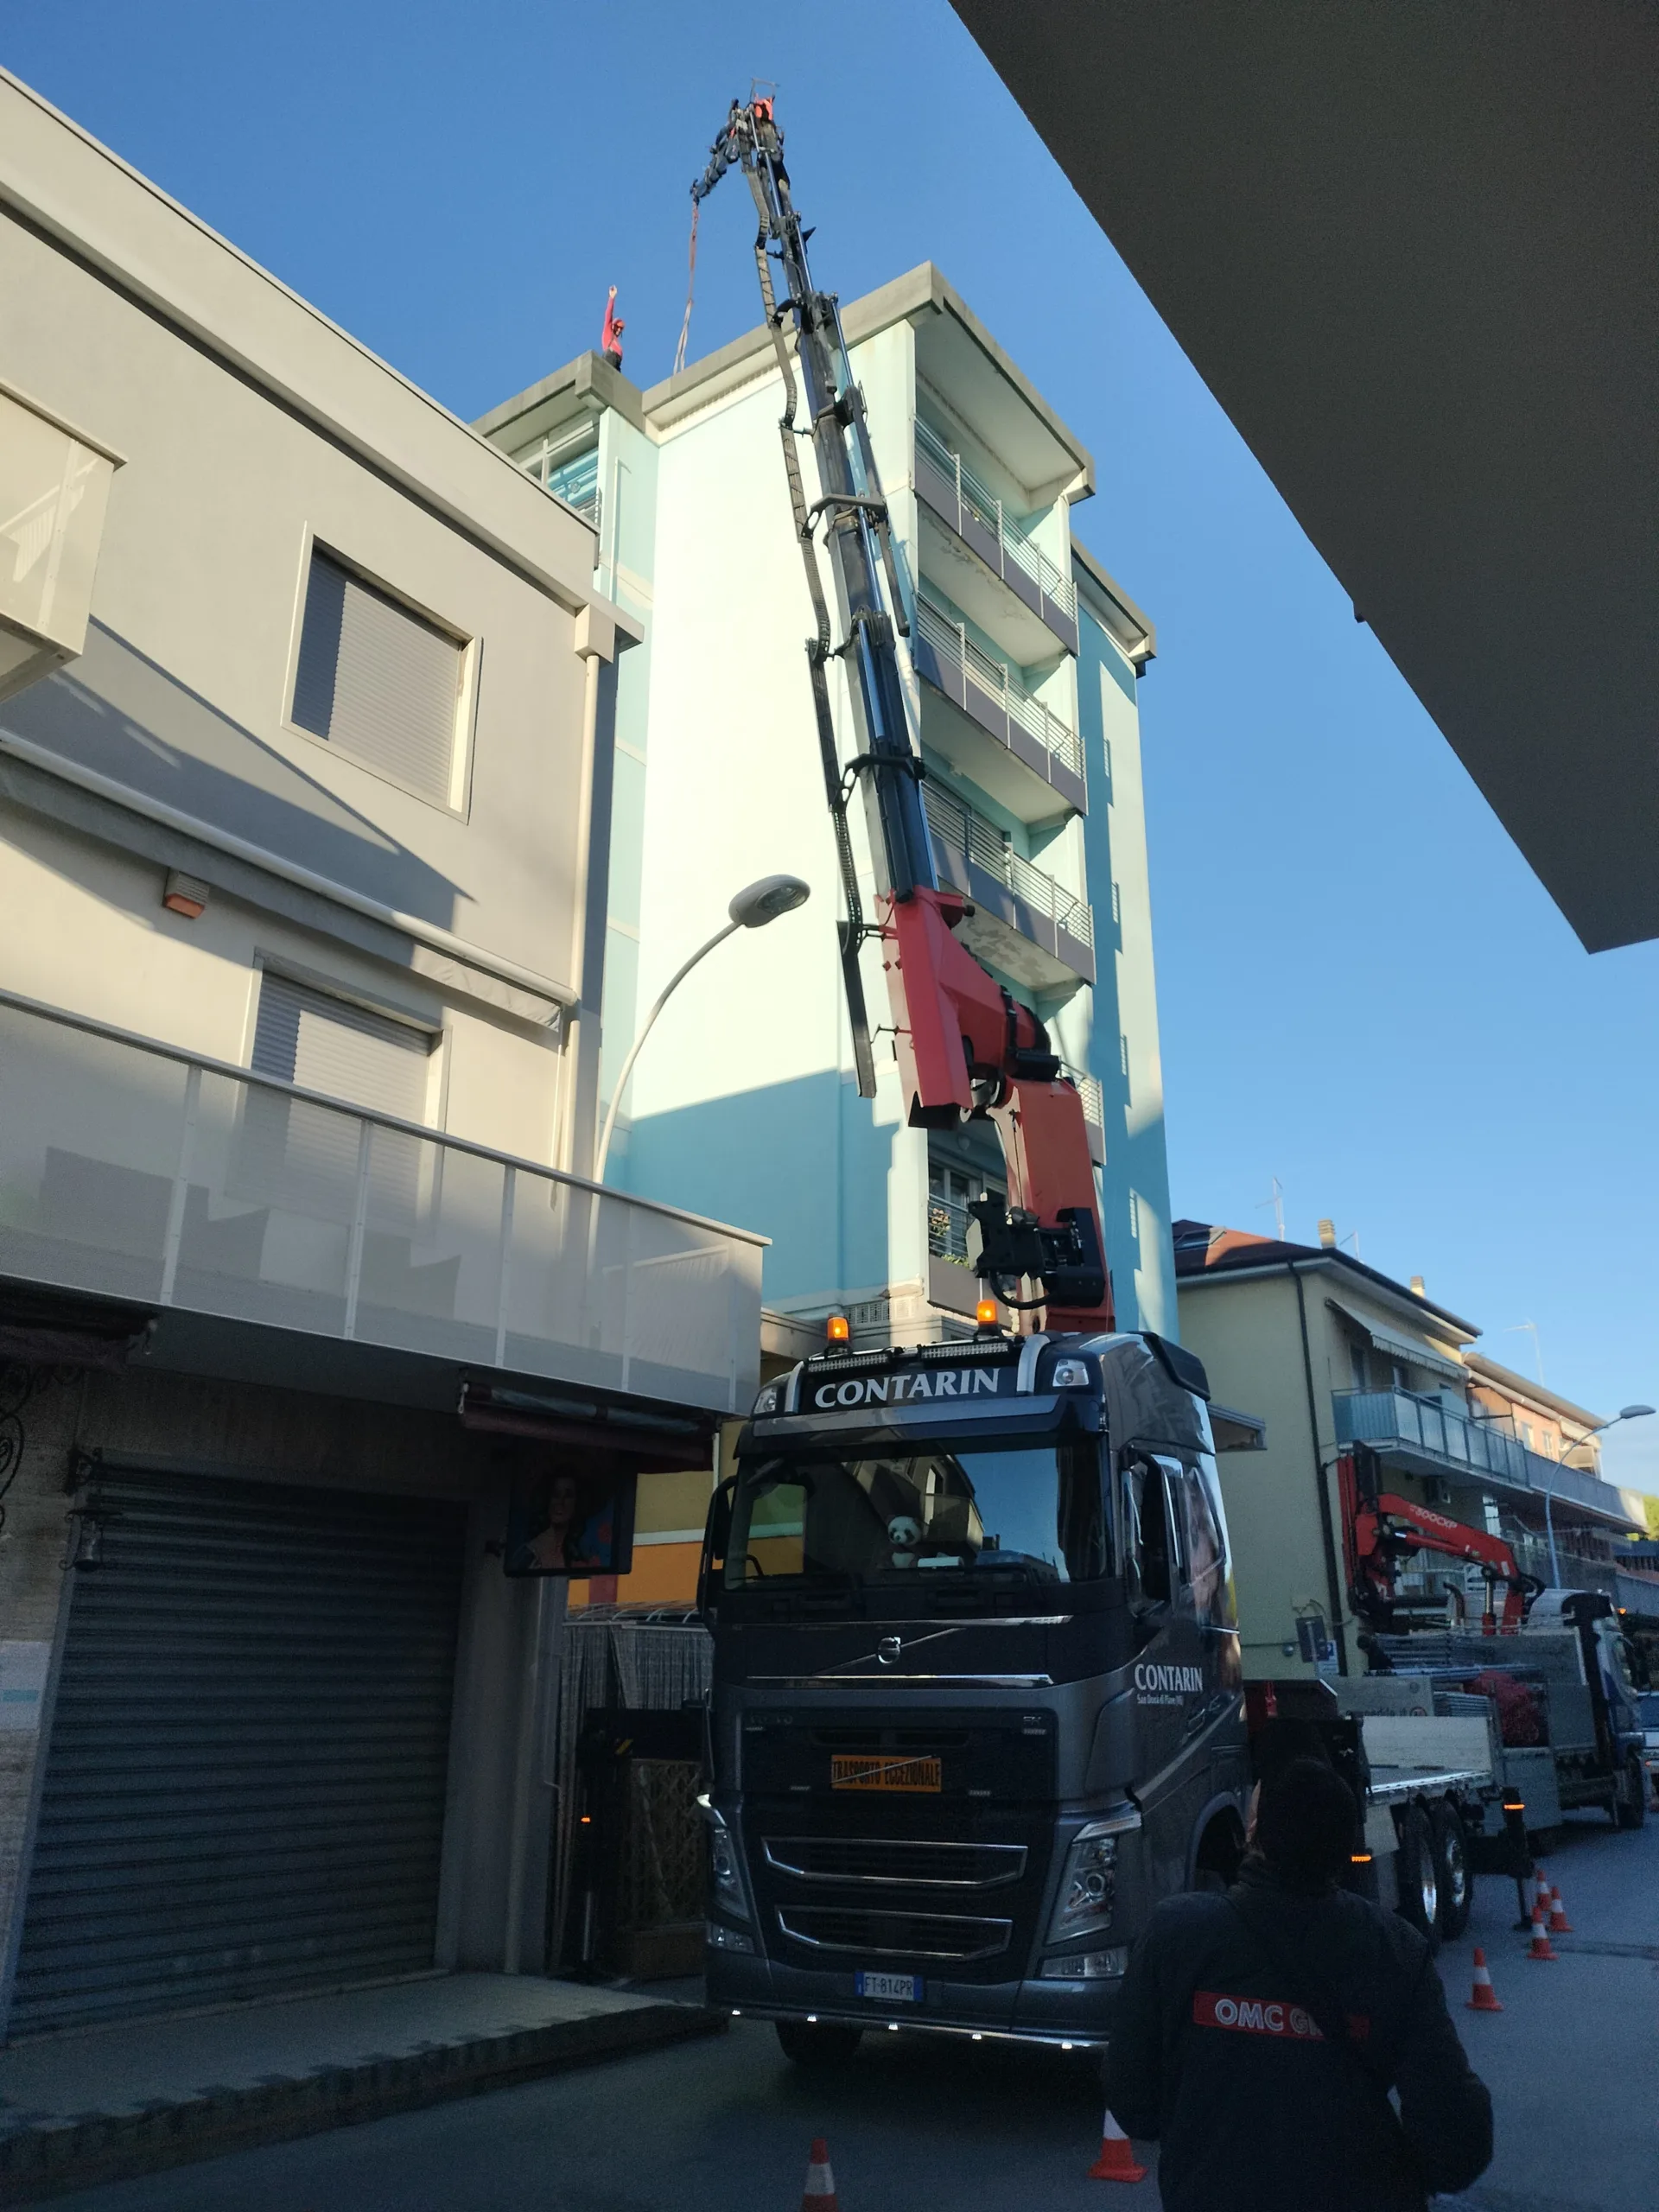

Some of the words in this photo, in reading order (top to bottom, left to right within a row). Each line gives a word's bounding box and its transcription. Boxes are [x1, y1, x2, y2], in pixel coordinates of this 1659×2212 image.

[815, 1368, 1001, 1408] CONTARIN
[1135, 1663, 1203, 1691] CONTARIN
[833, 1761, 881, 1784] TRASPORTO
[884, 1762, 940, 1787] ECCEZIONALE
[1214, 1998, 1285, 2032] OMC
